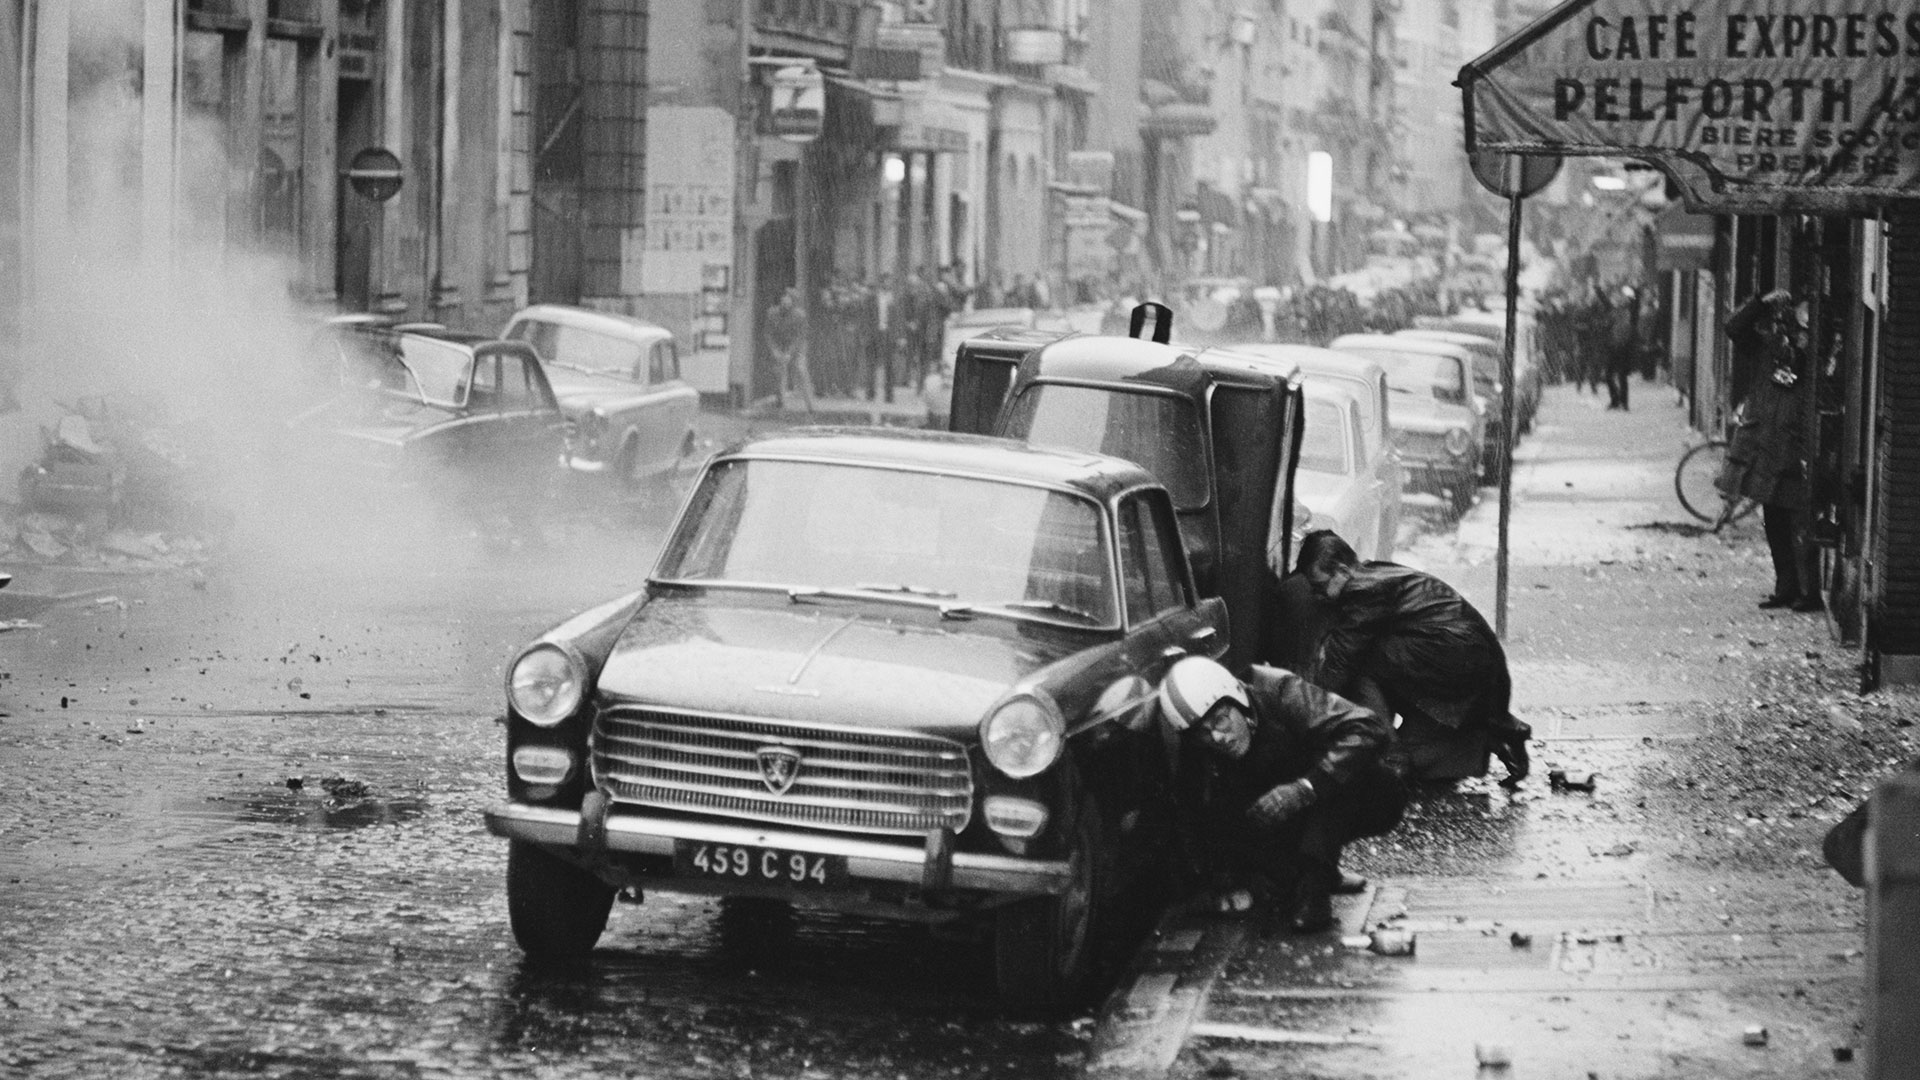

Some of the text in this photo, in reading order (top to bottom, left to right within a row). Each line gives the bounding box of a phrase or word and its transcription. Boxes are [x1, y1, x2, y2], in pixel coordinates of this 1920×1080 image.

[1727, 12, 1920, 58] EXPRESS
[1555, 77, 1853, 122] PELFORTH
[1701, 126, 1797, 147] BIERE
[693, 846, 827, 885] 459 C 94
